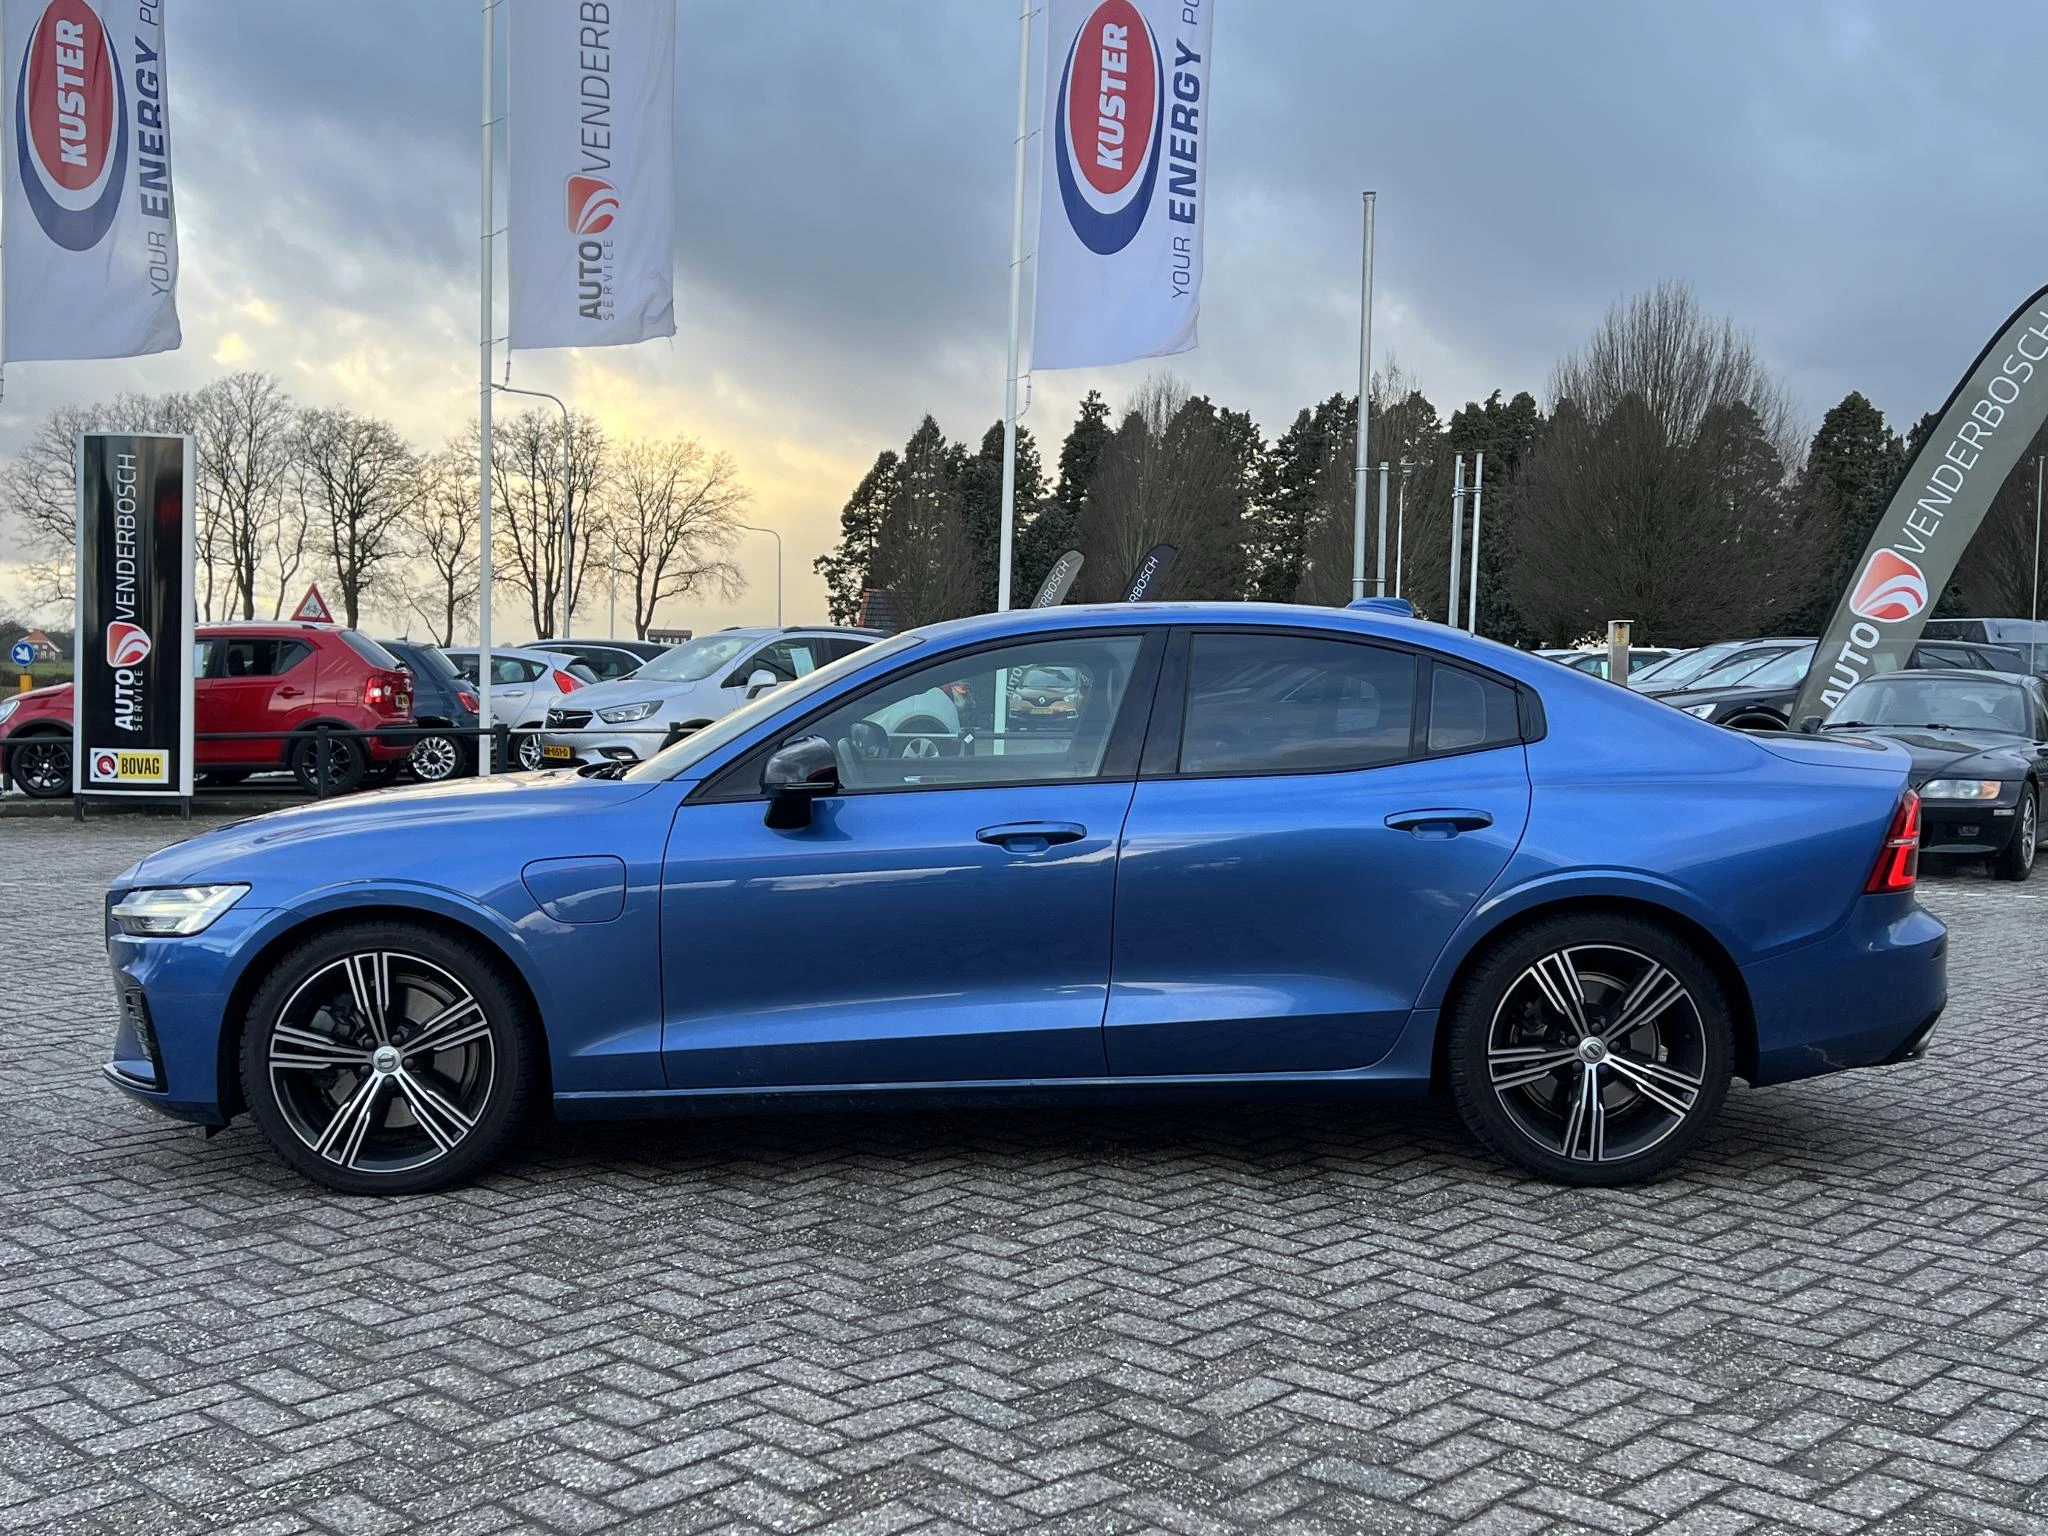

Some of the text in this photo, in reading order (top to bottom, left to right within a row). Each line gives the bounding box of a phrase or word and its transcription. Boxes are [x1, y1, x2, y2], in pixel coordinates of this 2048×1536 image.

[55, 19, 88, 167] KUSTER
[135, 36, 169, 220] ENERGY
[1096, 22, 1128, 171] KUSTER
[1169, 37, 1202, 225] ENERGY
[578, 2, 611, 321] AUTO VENDERB
[148, 231, 170, 297] YOUR
[602, 239, 614, 321] SERVICE
[1172, 236, 1191, 299] YOUR
[114, 453, 137, 731] AUTO VENDERBOSCH
[1037, 560, 1069, 608] RBOSCH
[133, 669, 144, 732] SERVICE
[1820, 622, 1880, 709] AUTO
[121, 757, 160, 775] BOVAG
